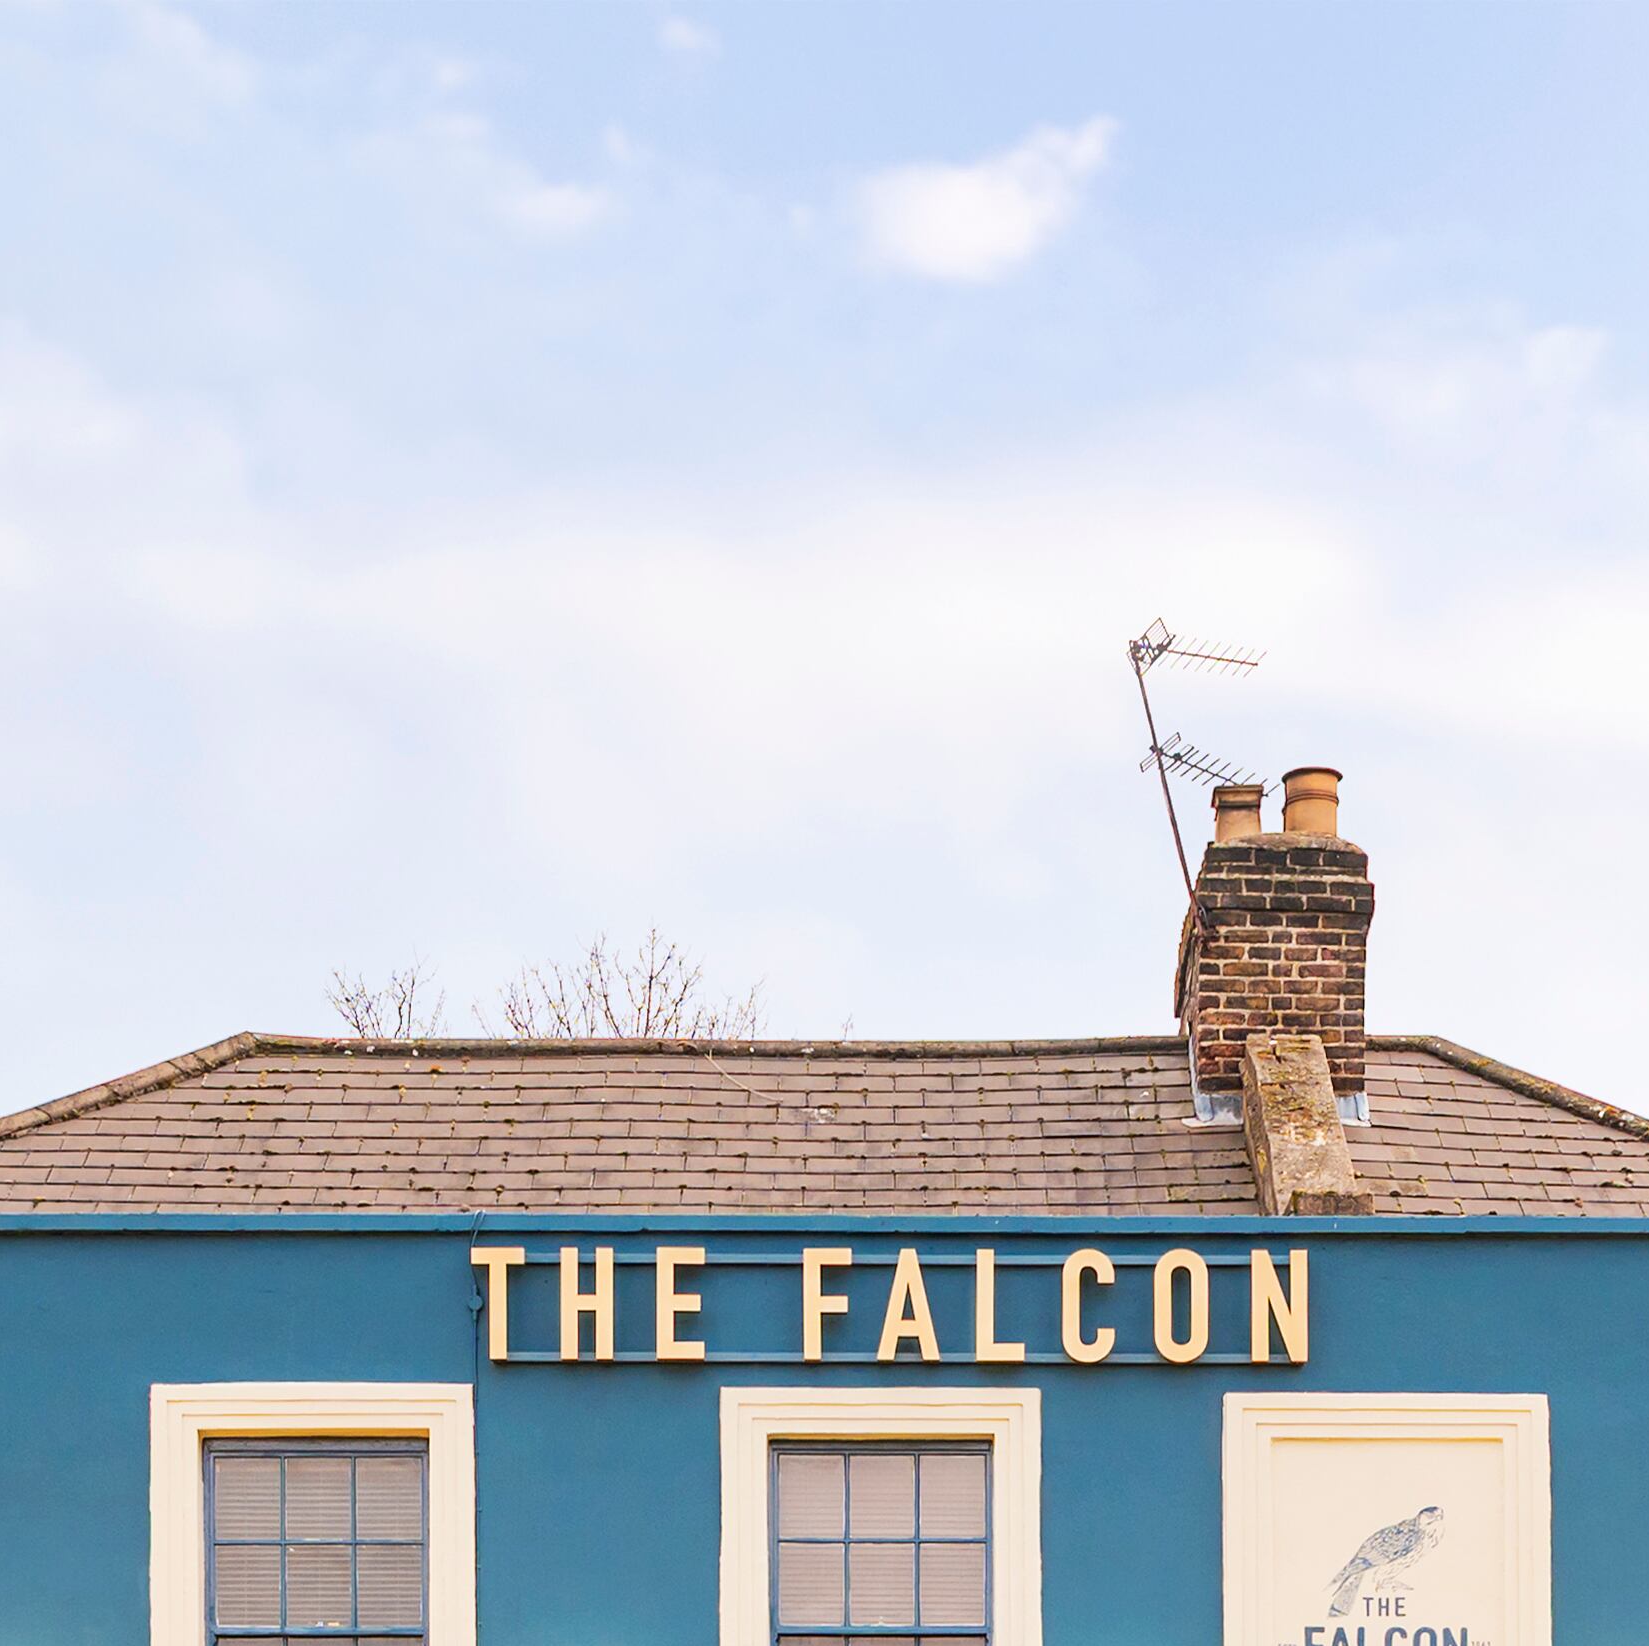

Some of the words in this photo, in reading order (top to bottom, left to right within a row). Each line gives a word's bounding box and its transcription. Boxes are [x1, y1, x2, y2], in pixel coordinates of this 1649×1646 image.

[470, 1246, 707, 1363] THE
[802, 1246, 1309, 1366] FALCON
[1363, 1596, 1407, 1615] THE
